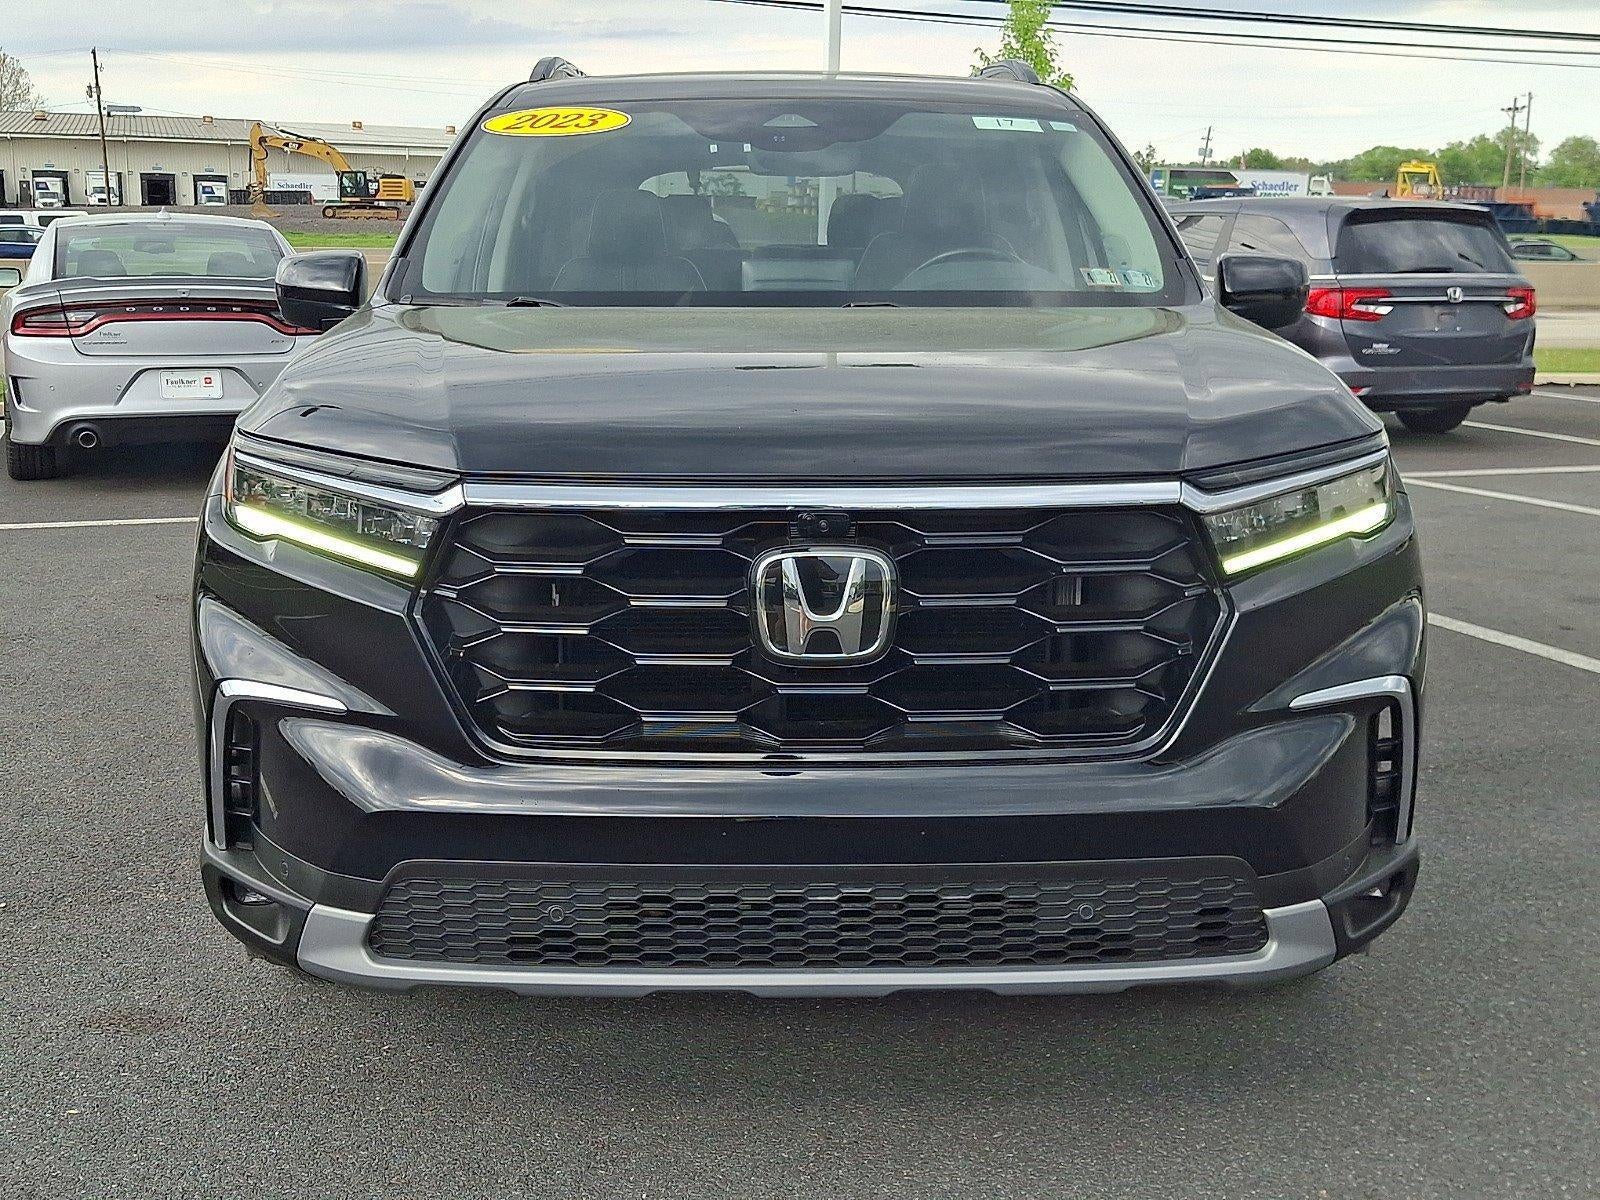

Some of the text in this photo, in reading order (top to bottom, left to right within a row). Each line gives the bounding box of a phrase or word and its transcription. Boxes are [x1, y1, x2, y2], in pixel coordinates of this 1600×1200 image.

[502, 113, 608, 130] 2023
[277, 182, 313, 190] Schaedler
[1251, 181, 1300, 192] Schaedler
[165, 378, 198, 386] Faulkner
